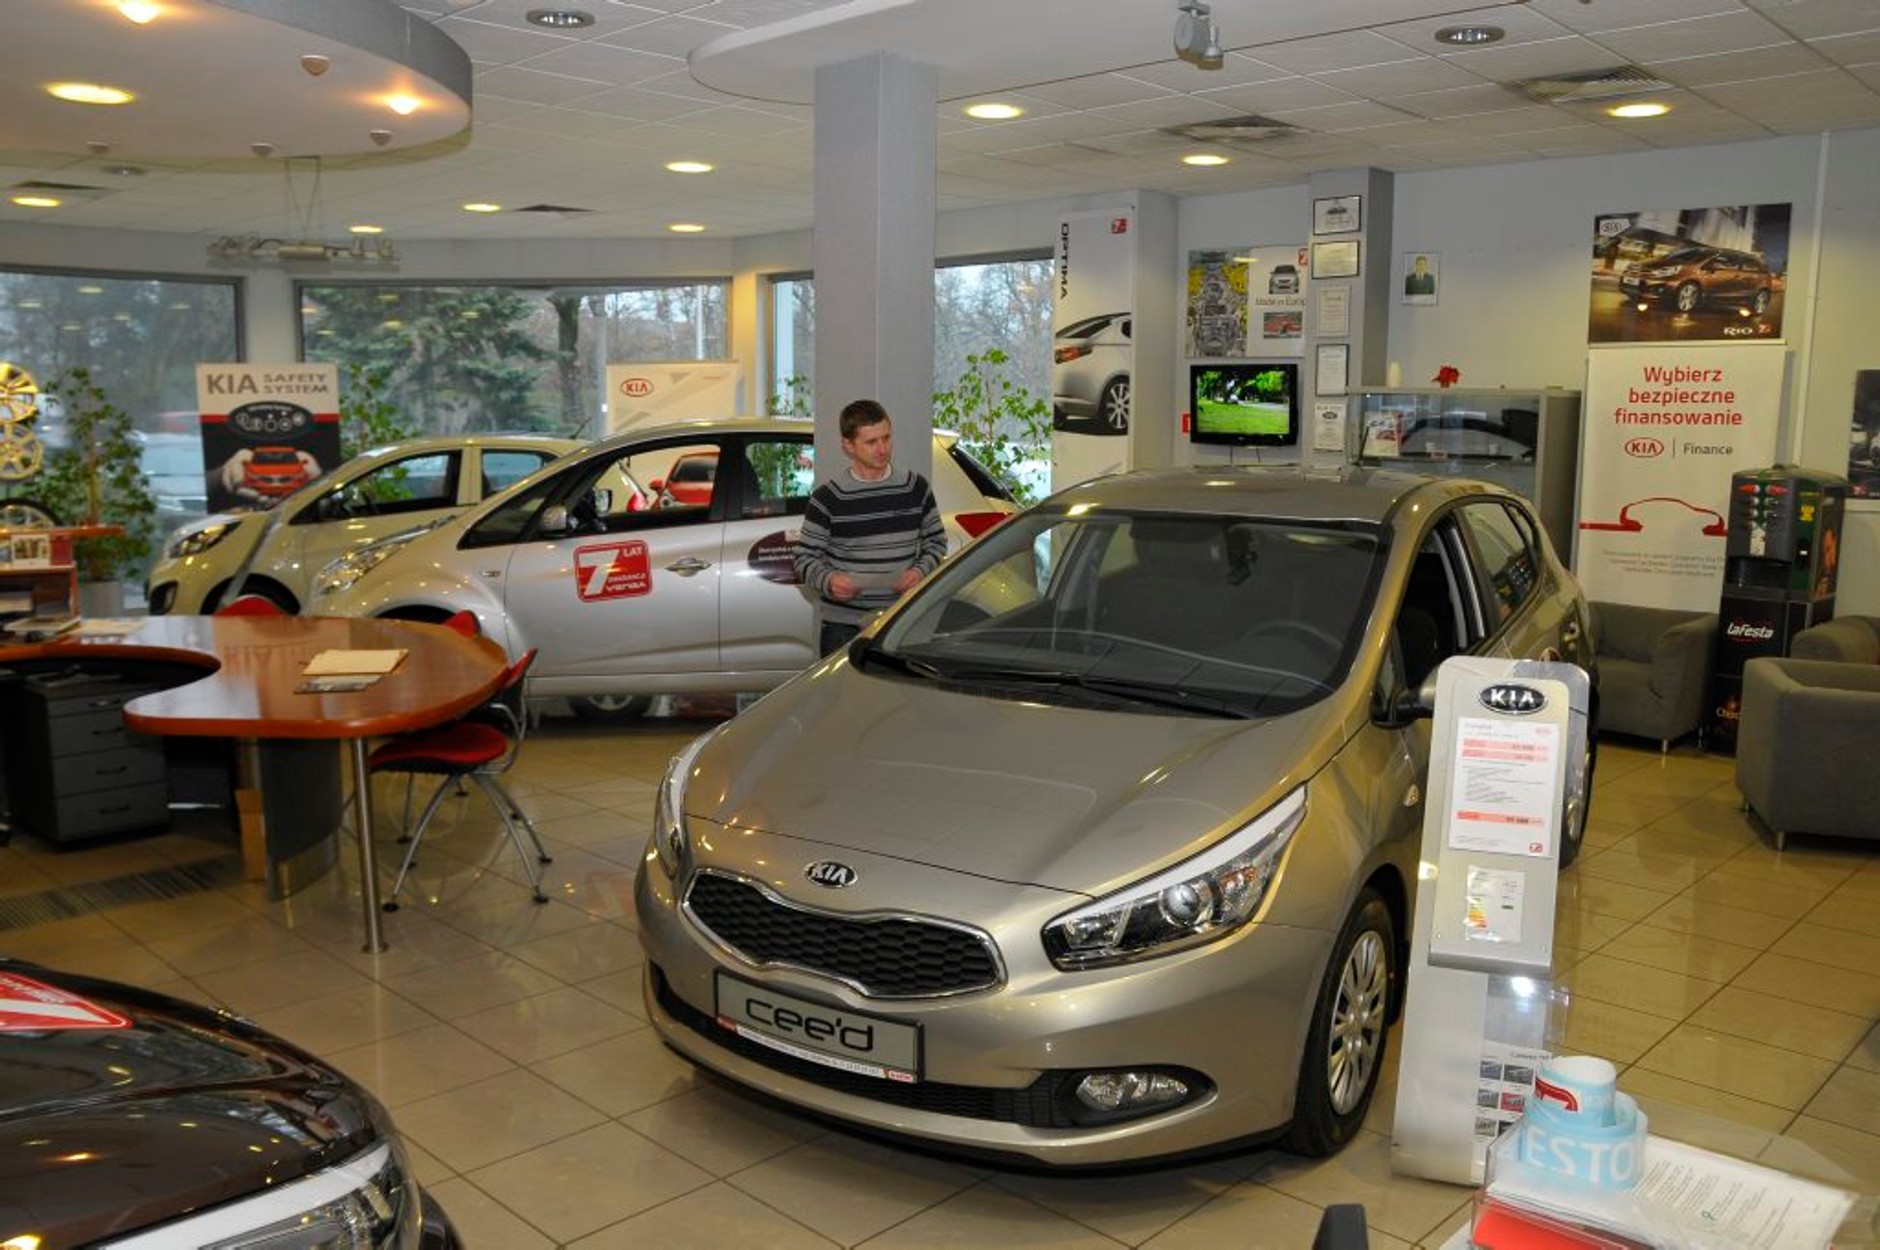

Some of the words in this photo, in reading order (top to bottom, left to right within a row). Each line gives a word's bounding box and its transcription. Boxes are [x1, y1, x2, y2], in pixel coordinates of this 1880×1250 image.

[1060, 222, 1069, 300] OPTIMA
[206, 373, 258, 395] KIA
[263, 373, 326, 383] SAFETY
[1643, 365, 1723, 387] Wybierz
[263, 384, 328, 394] SYSTEM
[625, 383, 648, 393] KIA
[1628, 387, 1735, 406] bezpieczne
[1614, 407, 1743, 425] finansowanie
[1630, 442, 1658, 454] KIA
[1683, 442, 1733, 455] Finance
[578, 548, 620, 596] 7
[623, 546, 643, 558] LAT
[1490, 688, 1537, 708] KIA
[810, 864, 848, 884] KIA
[745, 998, 873, 1051] cee'd
